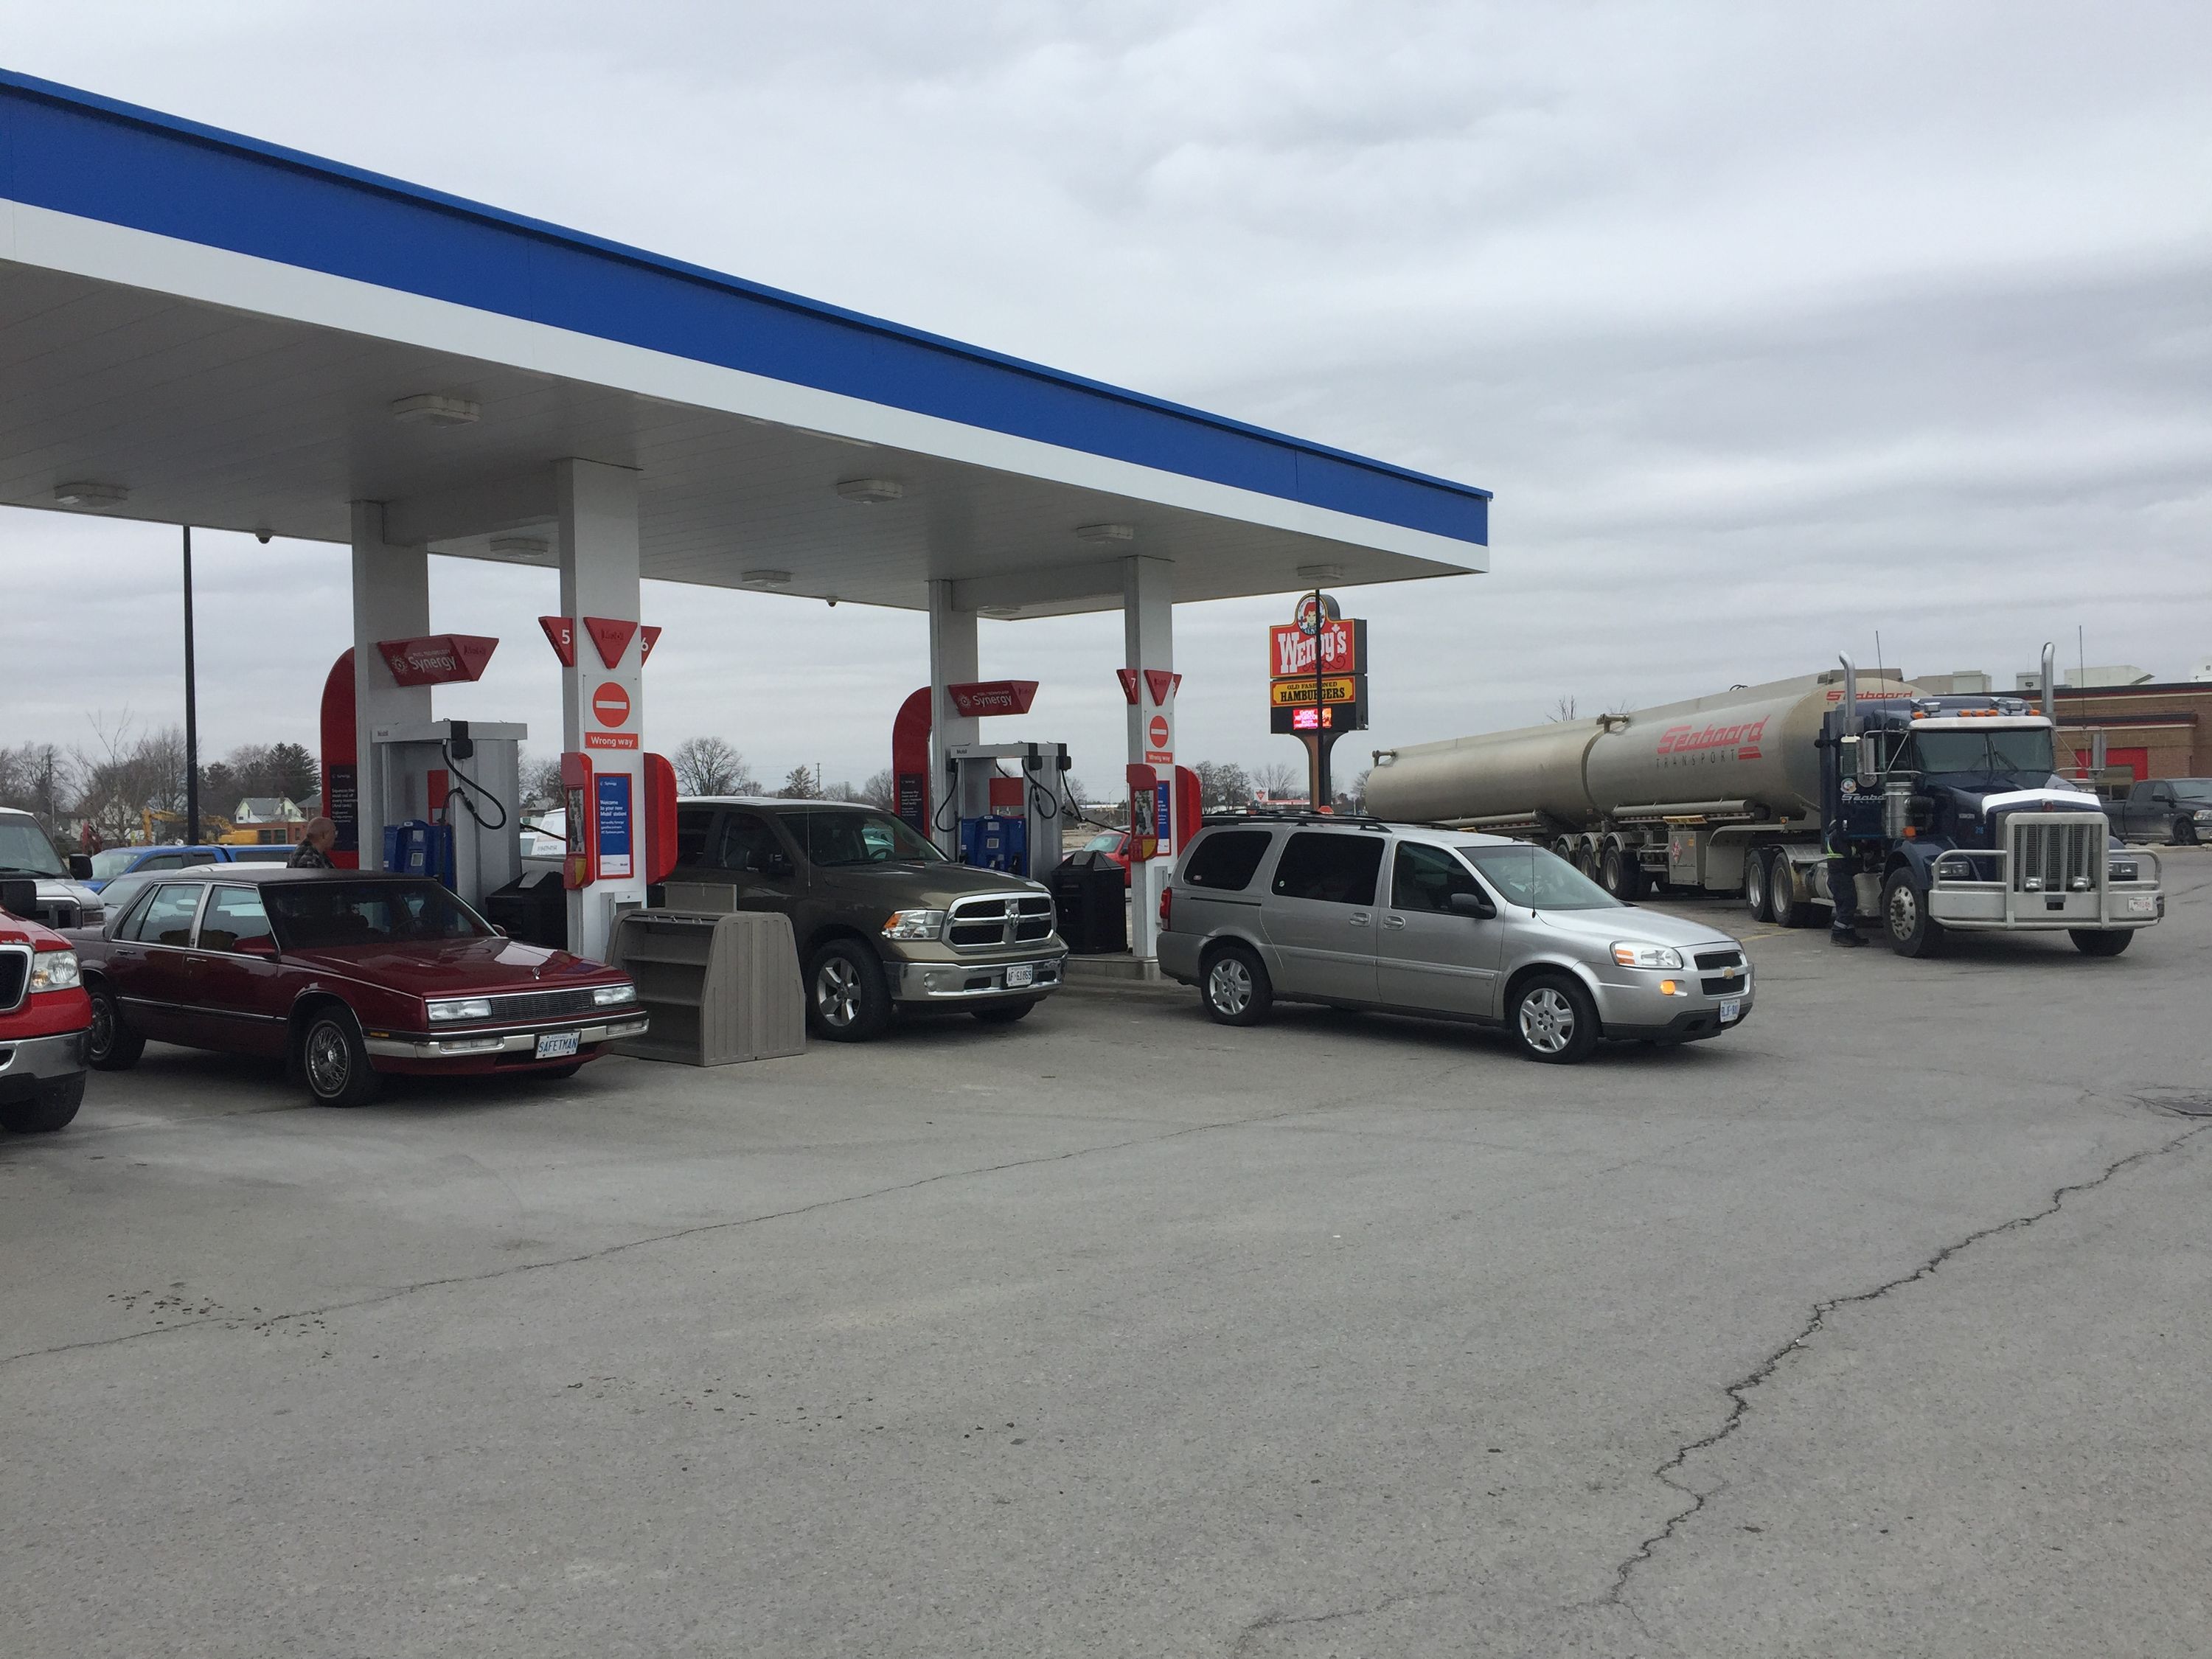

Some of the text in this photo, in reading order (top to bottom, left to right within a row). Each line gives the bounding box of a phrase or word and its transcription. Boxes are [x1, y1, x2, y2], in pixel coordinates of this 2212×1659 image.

[562, 629, 571, 644] 5
[641, 637, 649, 651] 6
[408, 655, 457, 673] Synergy
[1131, 678, 1136, 689] 7
[973, 695, 1012, 708] Synergy
[1826, 690, 1913, 701] Saboard
[1657, 714, 1771, 754] Seaboard
[591, 736, 634, 748] Wrong way
[1656, 749, 1735, 768] TRANSPORT
[1018, 821, 1022, 829] 7
